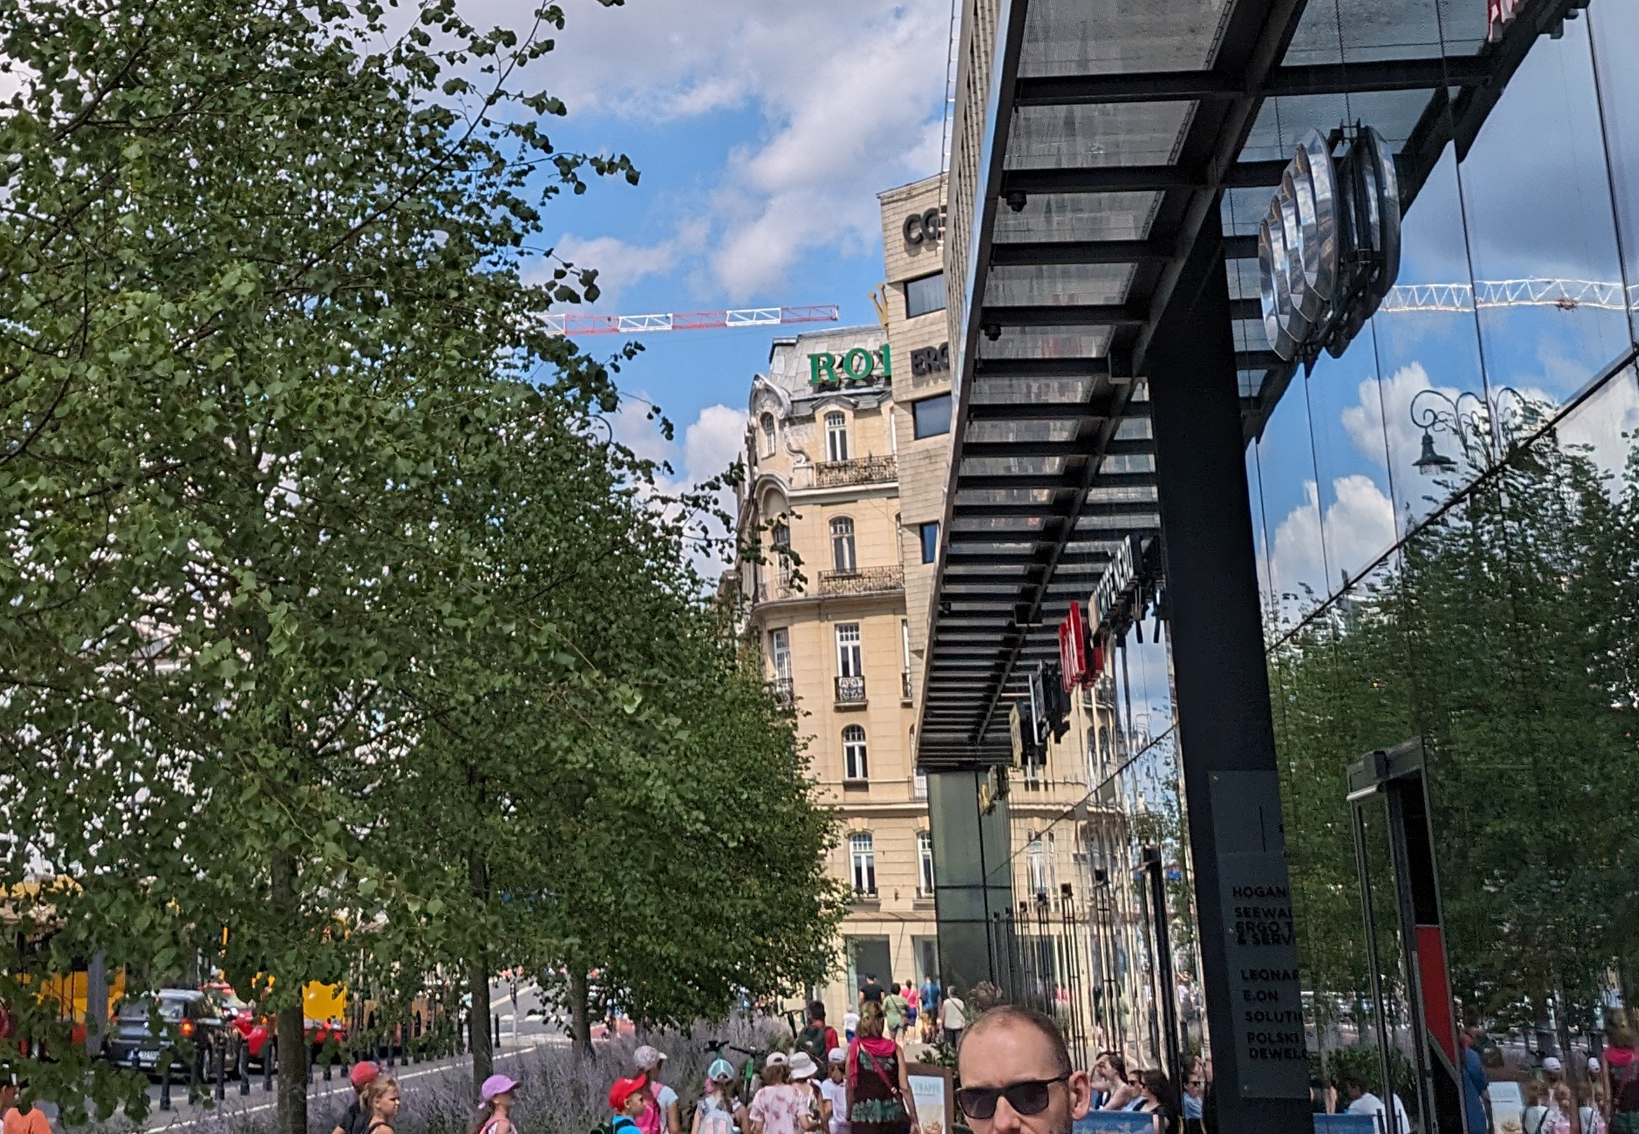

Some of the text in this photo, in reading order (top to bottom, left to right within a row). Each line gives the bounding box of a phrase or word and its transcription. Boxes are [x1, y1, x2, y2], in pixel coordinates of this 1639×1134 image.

[1232, 886, 1286, 897] HOGAN
[1236, 921, 1280, 933] ERGO
[1243, 989, 1278, 1002] E.ON
[1247, 1032, 1299, 1044] POLSKI
